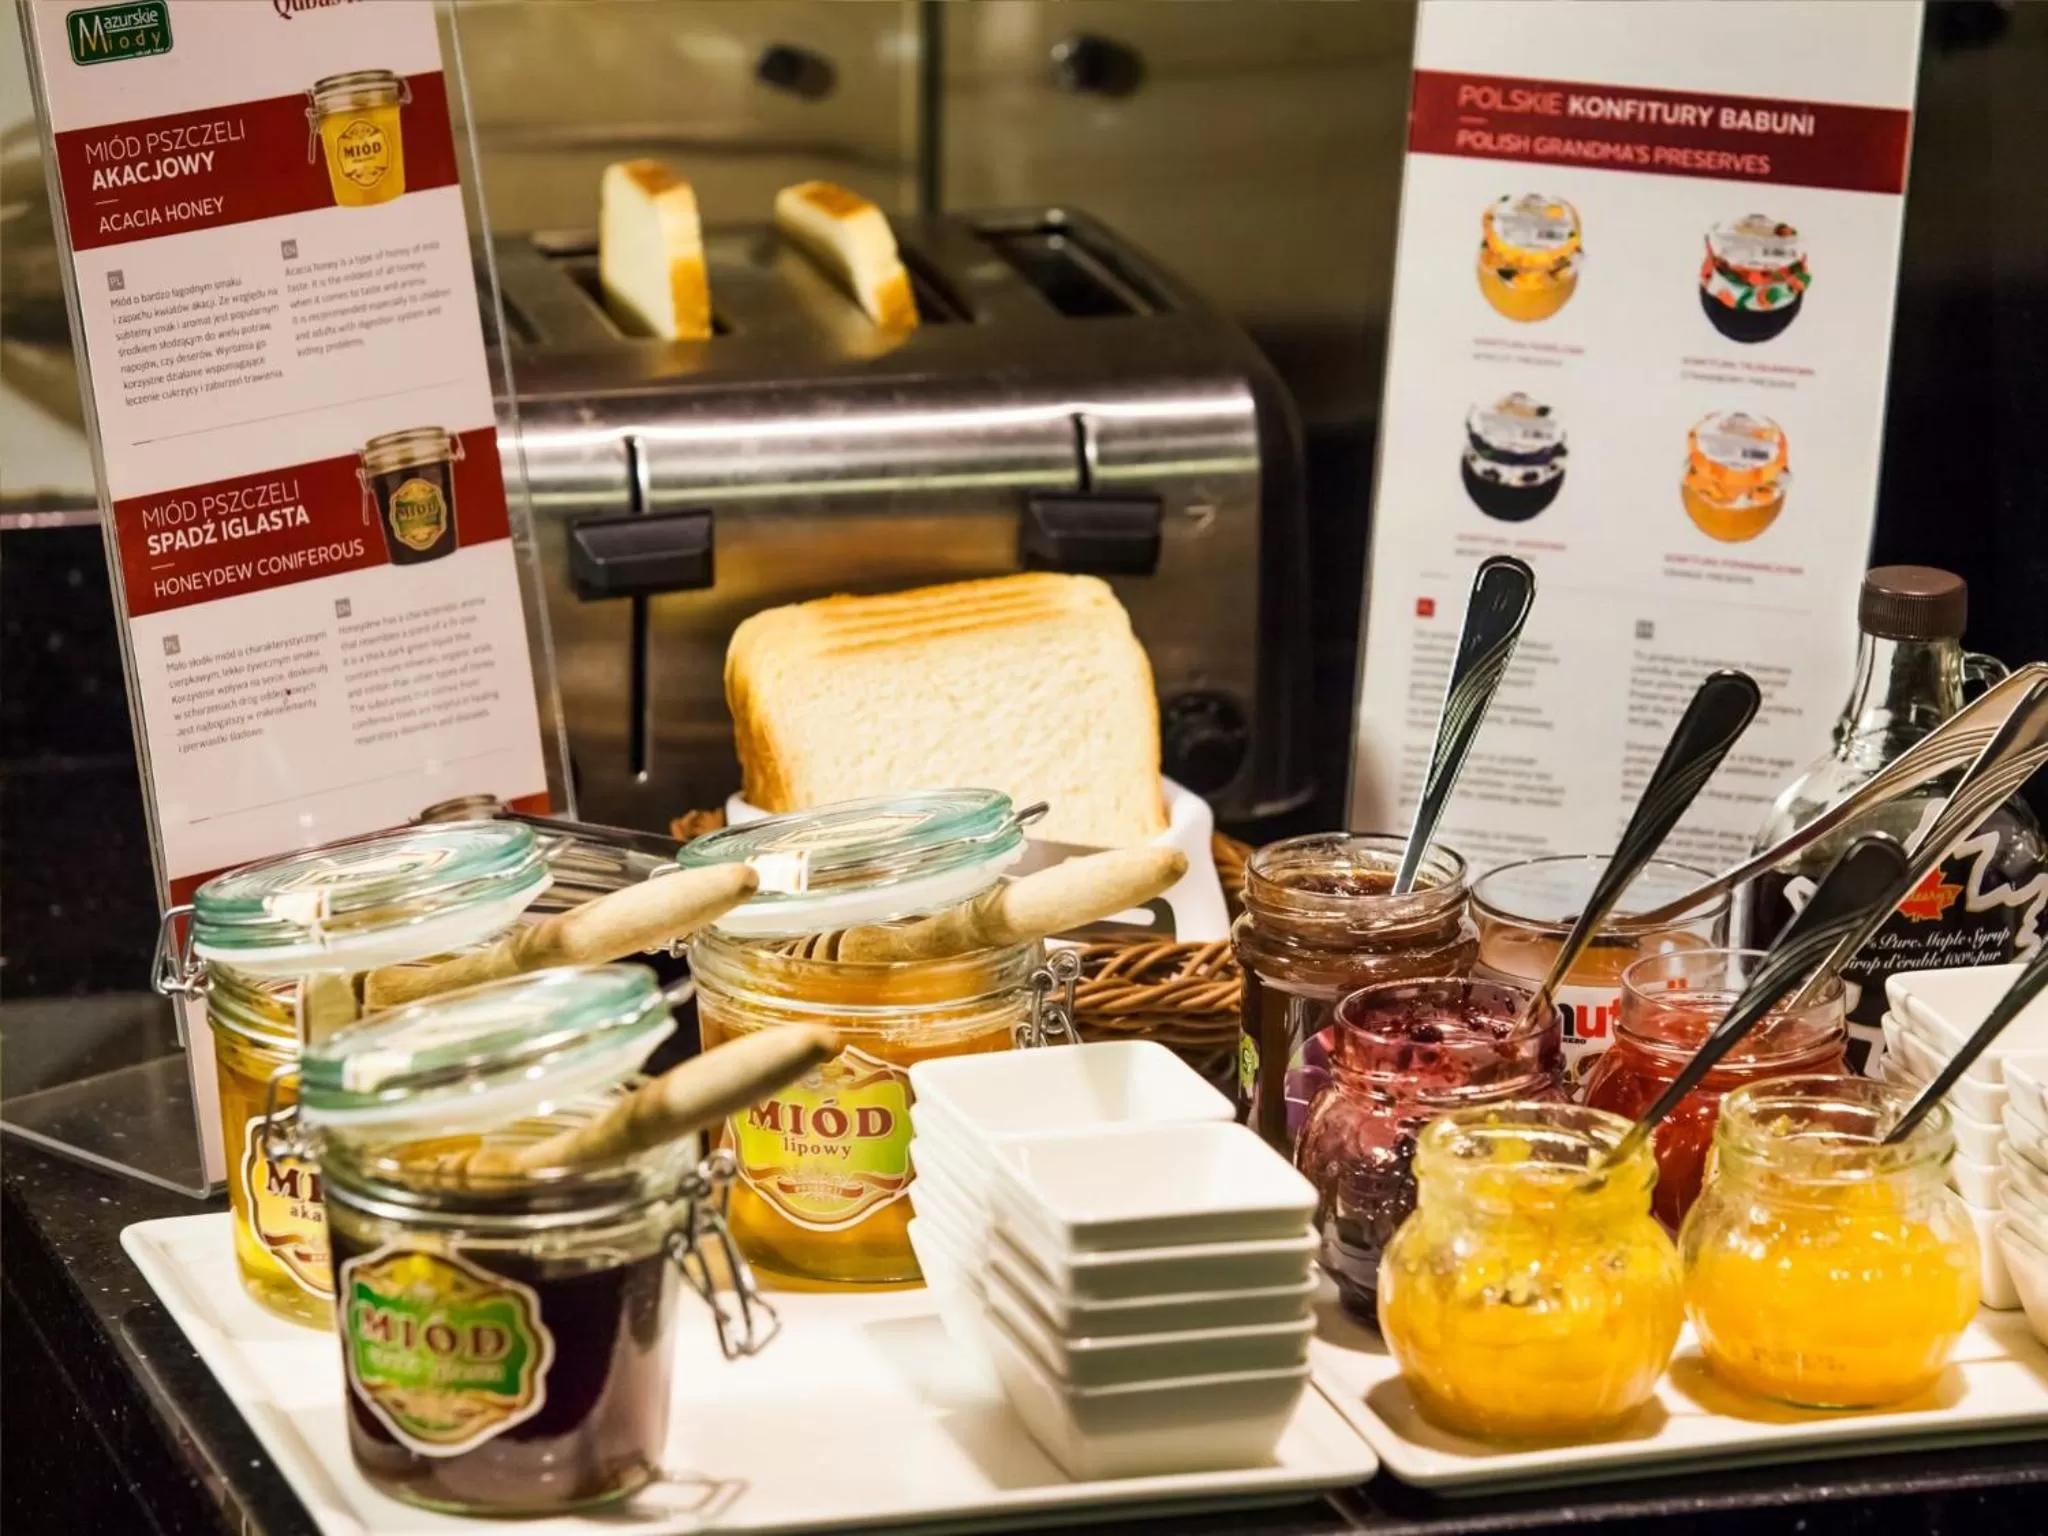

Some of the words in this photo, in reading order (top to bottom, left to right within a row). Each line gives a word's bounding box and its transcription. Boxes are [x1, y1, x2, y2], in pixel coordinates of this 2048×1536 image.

[1457, 84, 1564, 116] POLSKIE
[1567, 94, 1714, 128] KONFITURY
[1719, 106, 1816, 137] BABUNI
[85, 135, 141, 165] MIÓD
[145, 119, 246, 154] PSZCZELI
[1455, 128, 1531, 153] POLISH
[1532, 136, 1650, 165] GRANDMA'S
[1653, 146, 1771, 175] PRESERVES
[92, 150, 215, 192] AKACJOWY
[99, 206, 162, 233] ACACIA
[165, 196, 224, 222] HONEY
[141, 290, 170, 304] bardzo
[142, 501, 197, 530] MIÓD
[202, 480, 300, 518] PSZCZELI
[222, 505, 310, 541] IGLASTA
[153, 563, 253, 598] HONEYDEW
[257, 538, 365, 576] CONIFEROUS
[1926, 929, 1967, 951] Maple
[1968, 925, 2011, 950] Syrup
[749, 1098, 893, 1138] MIÓD
[784, 1138, 852, 1160] lipowy
